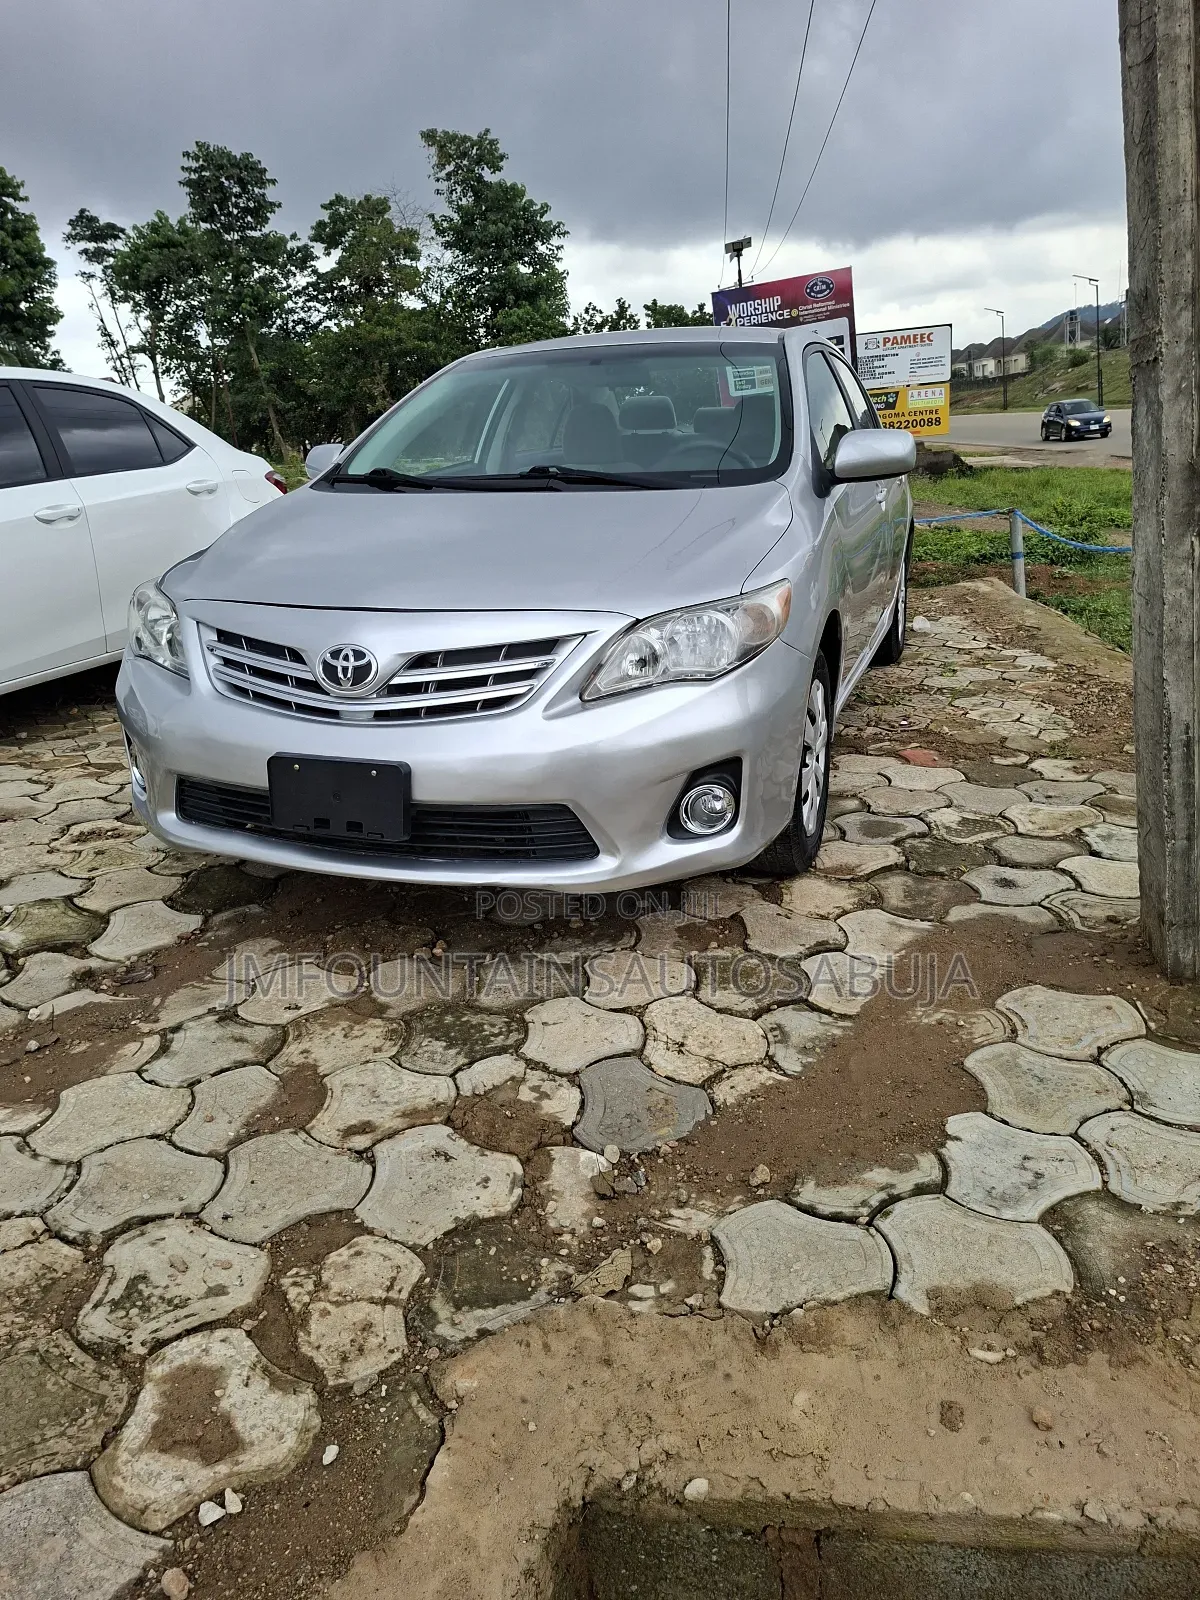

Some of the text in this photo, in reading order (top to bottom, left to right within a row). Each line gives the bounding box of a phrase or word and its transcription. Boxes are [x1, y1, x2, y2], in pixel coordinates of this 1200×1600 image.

[727, 295, 782, 317] WORSHIP
[882, 332, 934, 346] PAMEEC
[910, 390, 943, 399] ARENA
[908, 409, 939, 417] CENTRE
